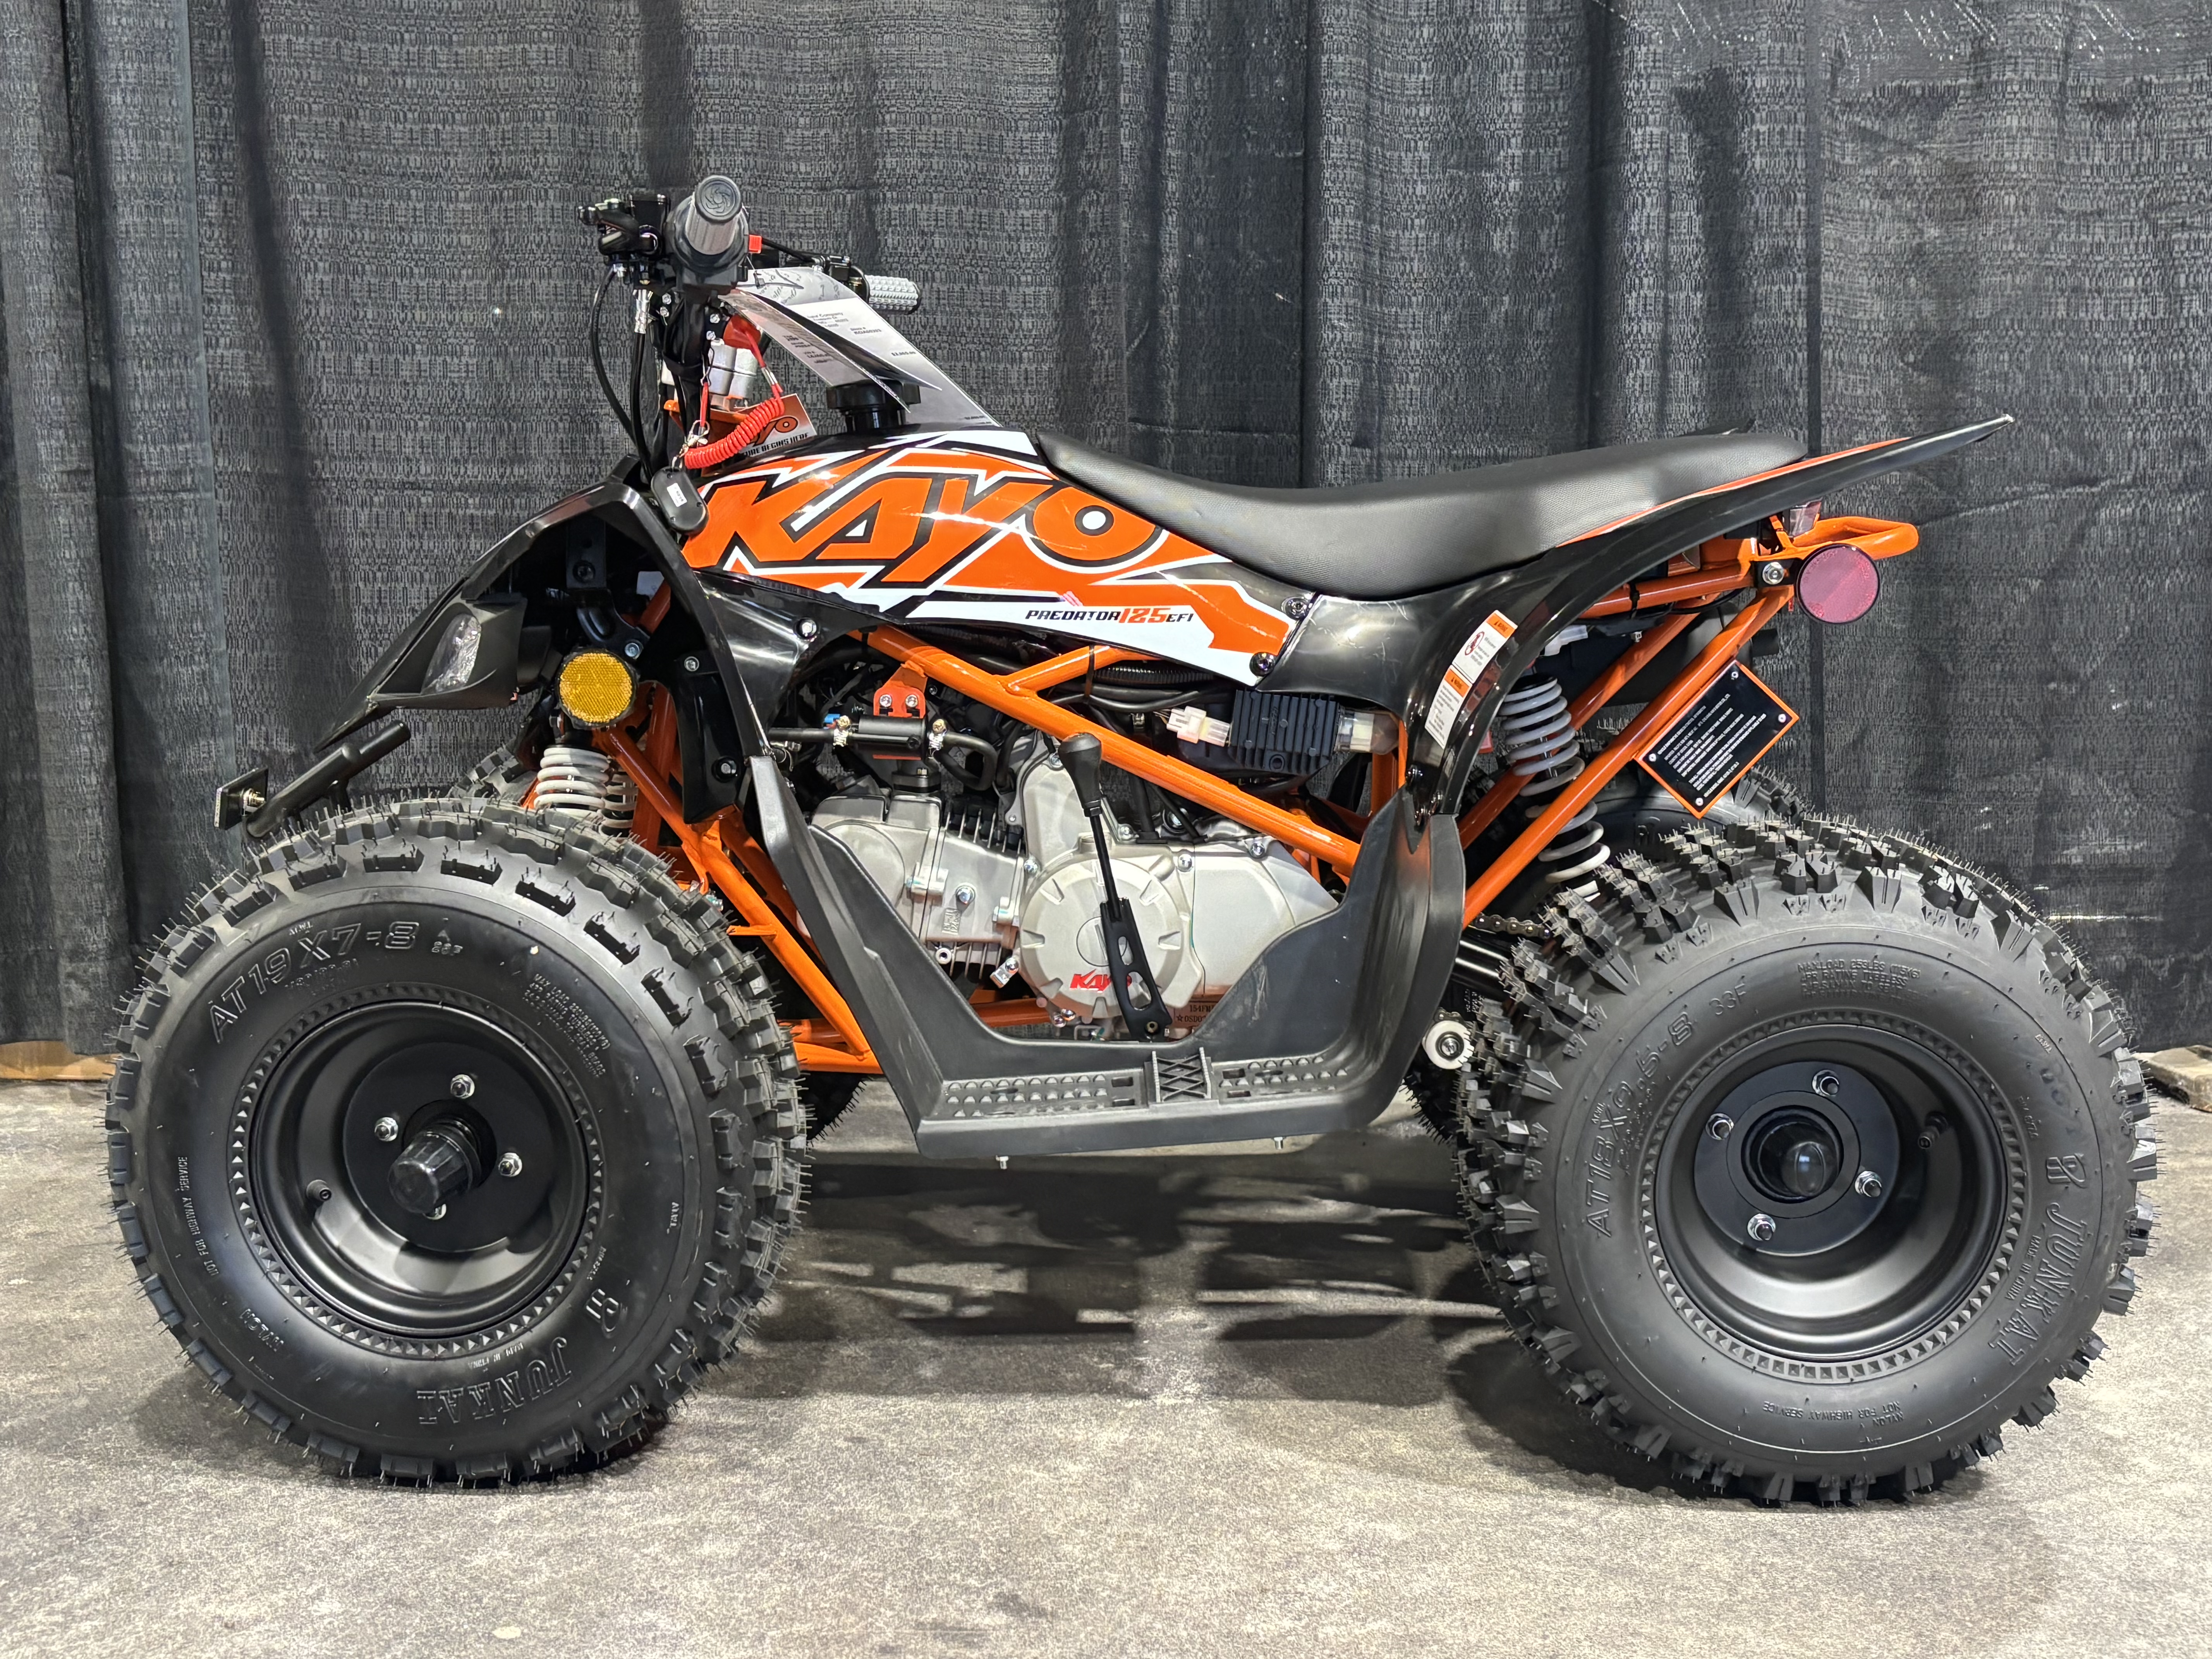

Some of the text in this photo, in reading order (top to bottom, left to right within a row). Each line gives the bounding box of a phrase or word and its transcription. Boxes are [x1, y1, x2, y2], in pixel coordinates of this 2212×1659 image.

[761, 438, 789, 452] BEGINS
[682, 451, 1157, 583] KAYO
[1707, 983, 1751, 1016] 33F
[178, 1156, 190, 1191] SERVICE
[182, 1195, 201, 1235] HIGHWAY
[194, 1238, 209, 1257] FOR
[1987, 1202, 2087, 1366] JUNKAI
[2003, 1234, 2041, 1304] MADE IN CHINA
[416, 1334, 574, 1424] JUNKAI
[1761, 1400, 1901, 1420] NOT FOR HIGHWAY SERVICE
